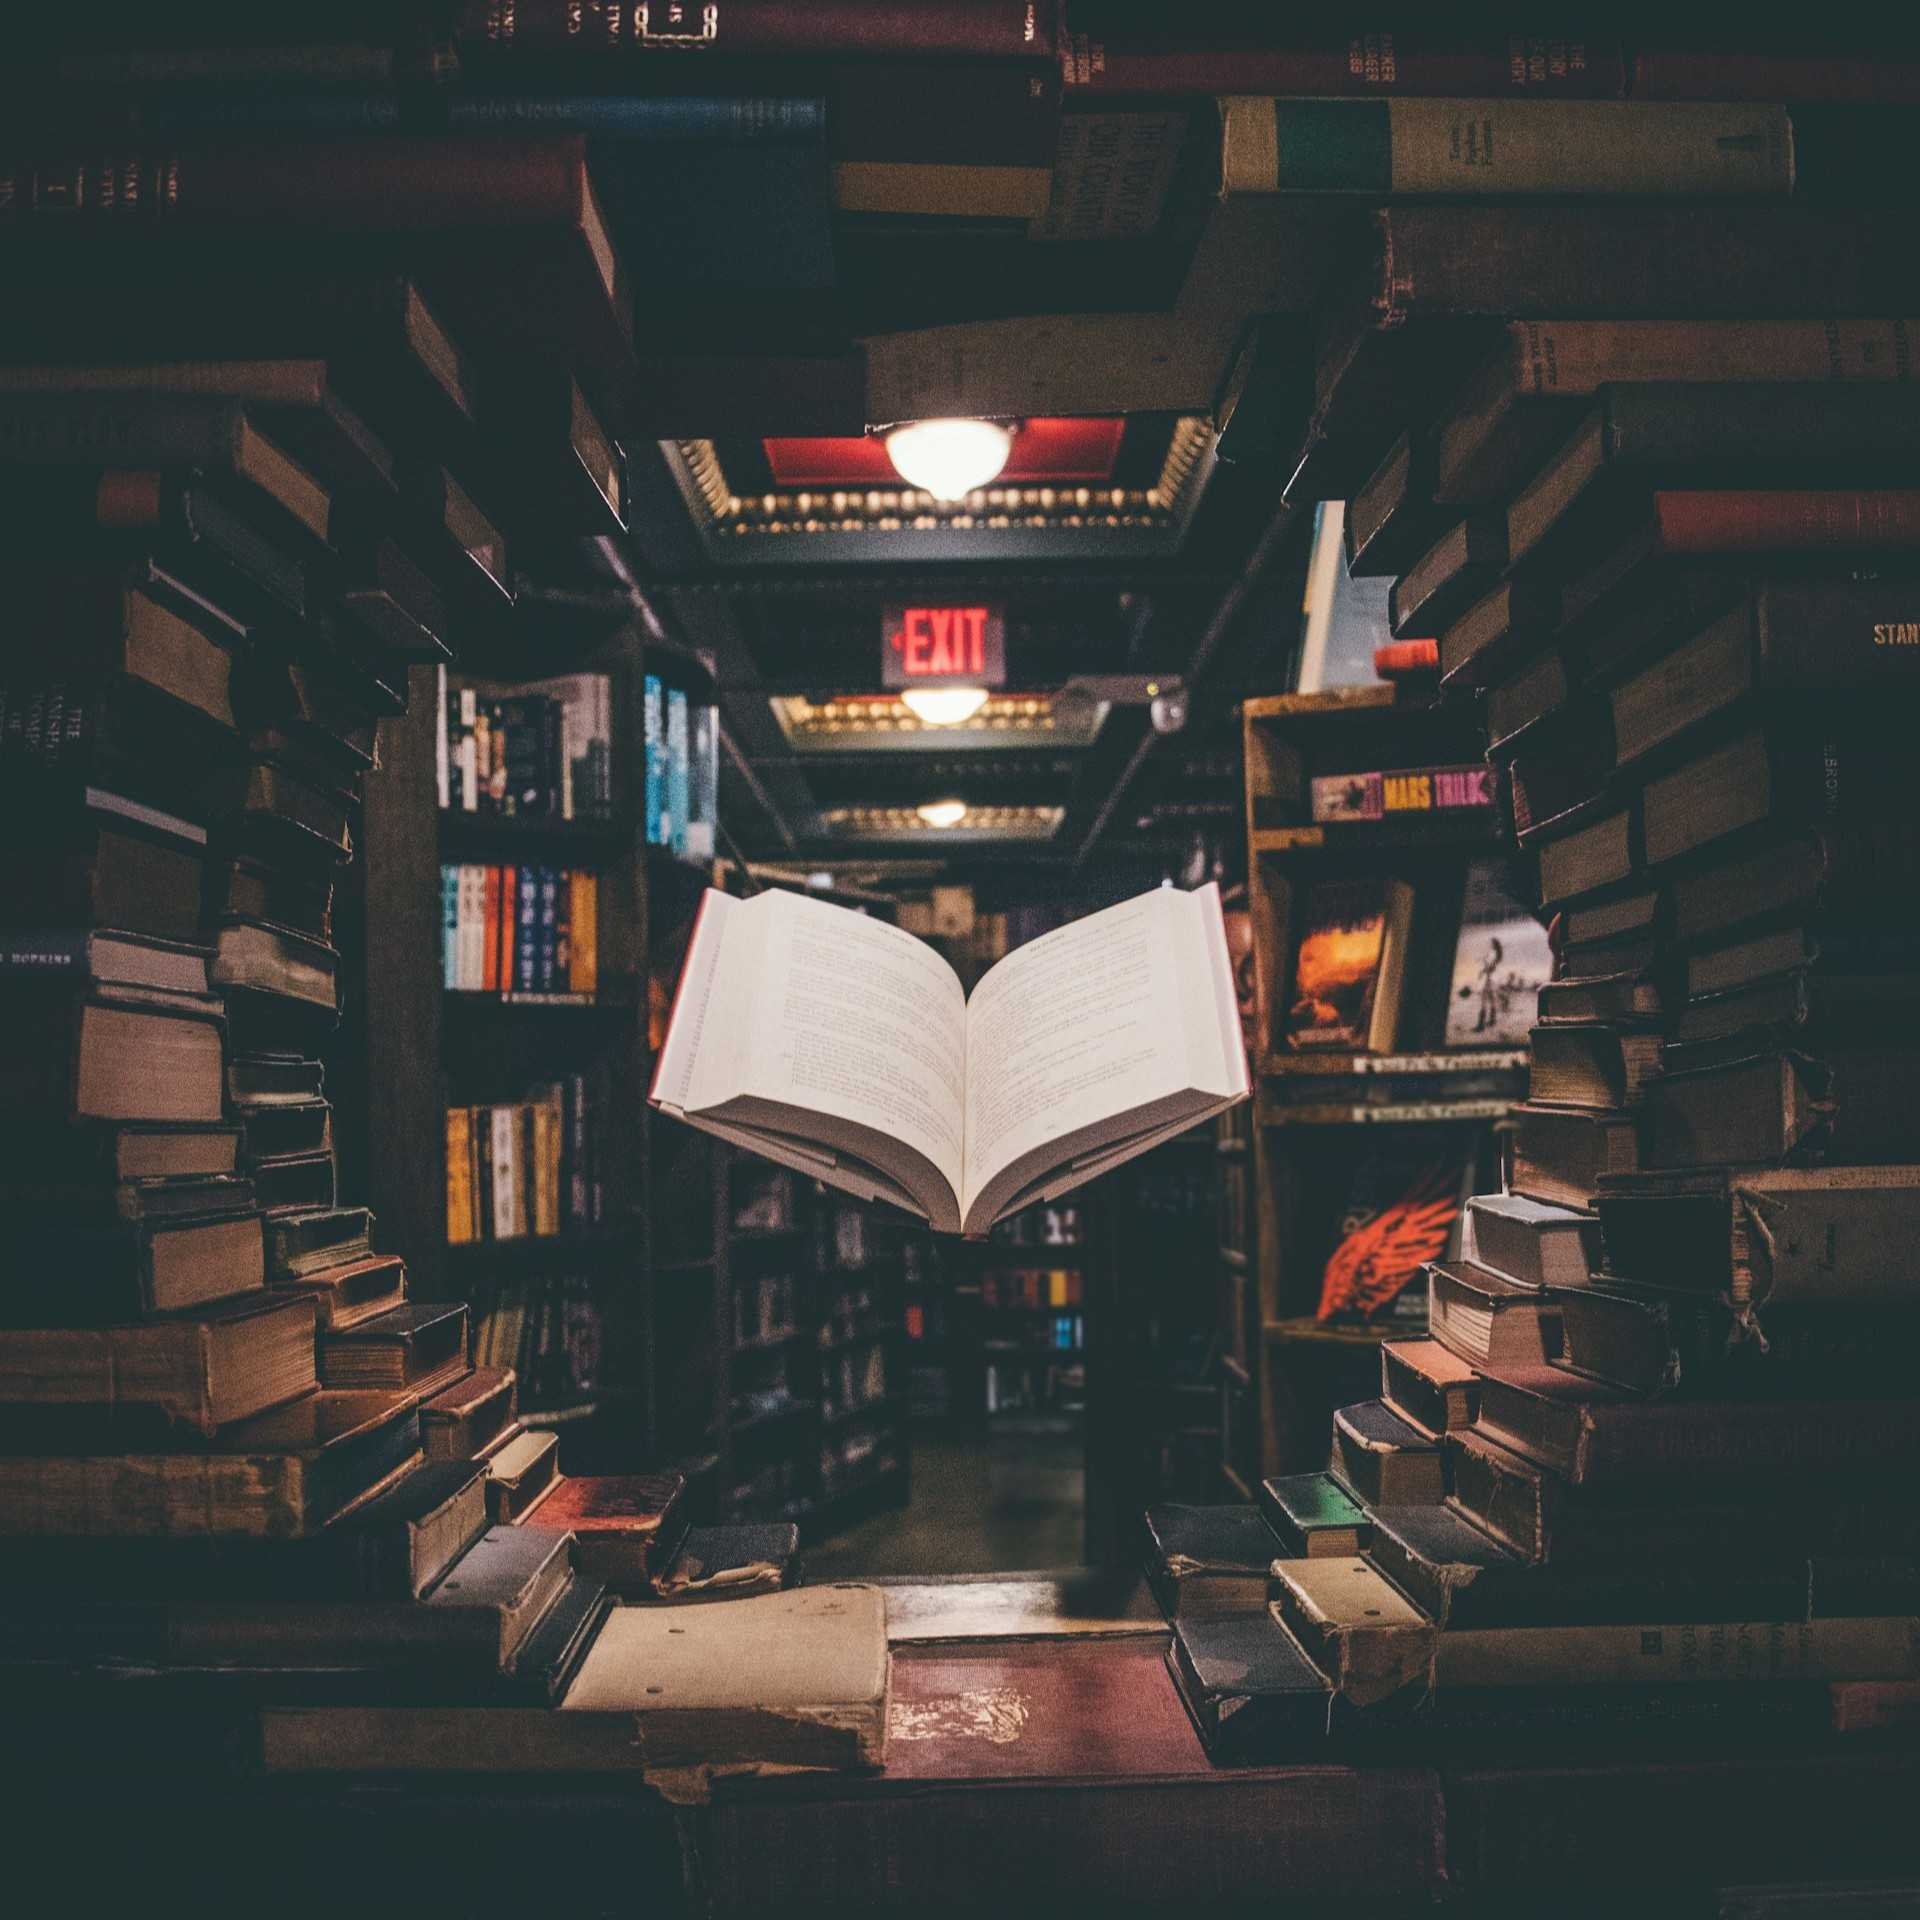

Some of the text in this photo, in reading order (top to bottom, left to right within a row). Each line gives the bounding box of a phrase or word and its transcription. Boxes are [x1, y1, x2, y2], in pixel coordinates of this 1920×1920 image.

[904, 608, 988, 673] EXIT
[1873, 623, 1920, 645] STAN
[1384, 775, 1431, 810] MARS
